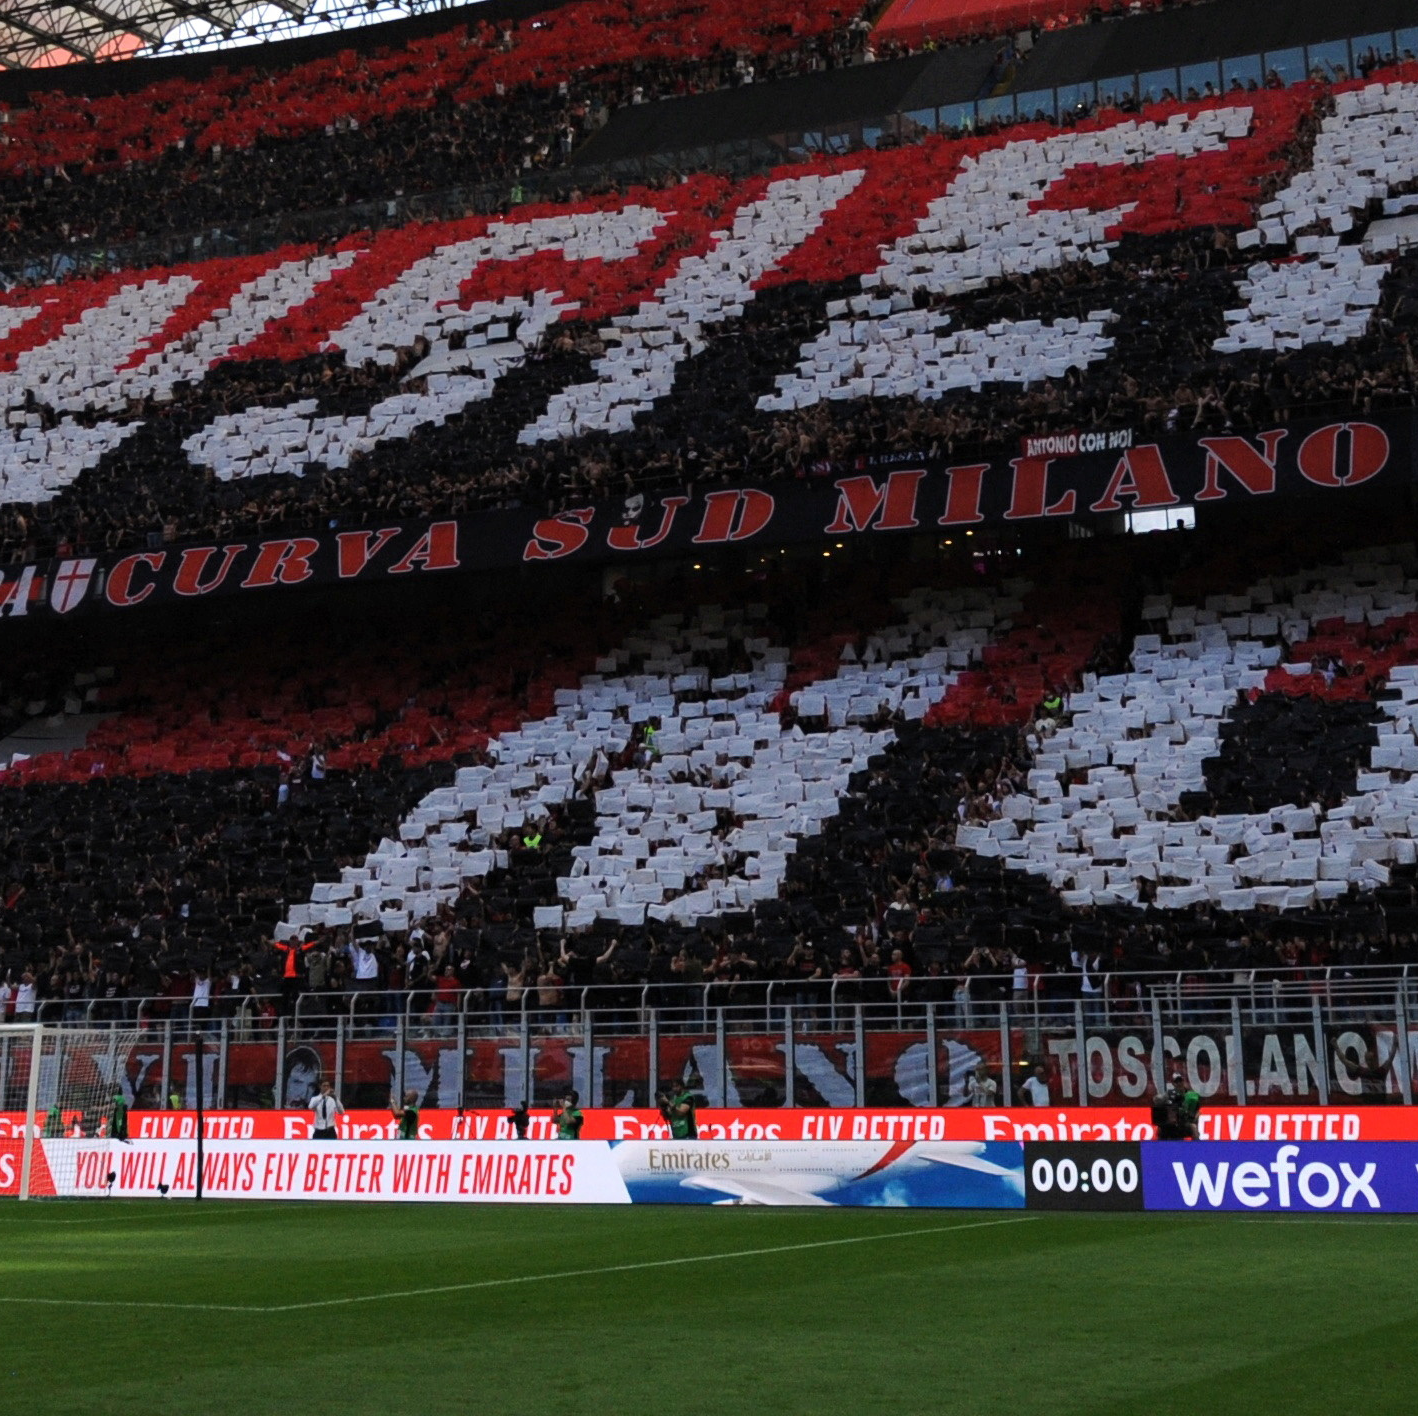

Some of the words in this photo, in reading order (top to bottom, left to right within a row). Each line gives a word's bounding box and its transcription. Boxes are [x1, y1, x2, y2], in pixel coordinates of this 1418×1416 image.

[1027, 434, 1076, 457] ANTONIO
[1078, 430, 1106, 453] CON
[1108, 428, 1133, 449] NOI
[105, 521, 461, 606] CURVA
[524, 488, 776, 561] SUD
[824, 421, 1390, 534] MILANO
[982, 1112, 1155, 1141] Emirate
[74, 1151, 114, 1189] YOU
[119, 1151, 168, 1190] WILL
[173, 1151, 257, 1191] ALWAYS
[262, 1152, 300, 1191] FLY
[302, 1153, 385, 1193] BETTER
[392, 1154, 452, 1194] WITH
[458, 1154, 575, 1195] EMIRATES
[648, 1147, 730, 1171] Emirates
[1031, 1158, 1139, 1193] 00:00
[1171, 1144, 1381, 1209] wefox
